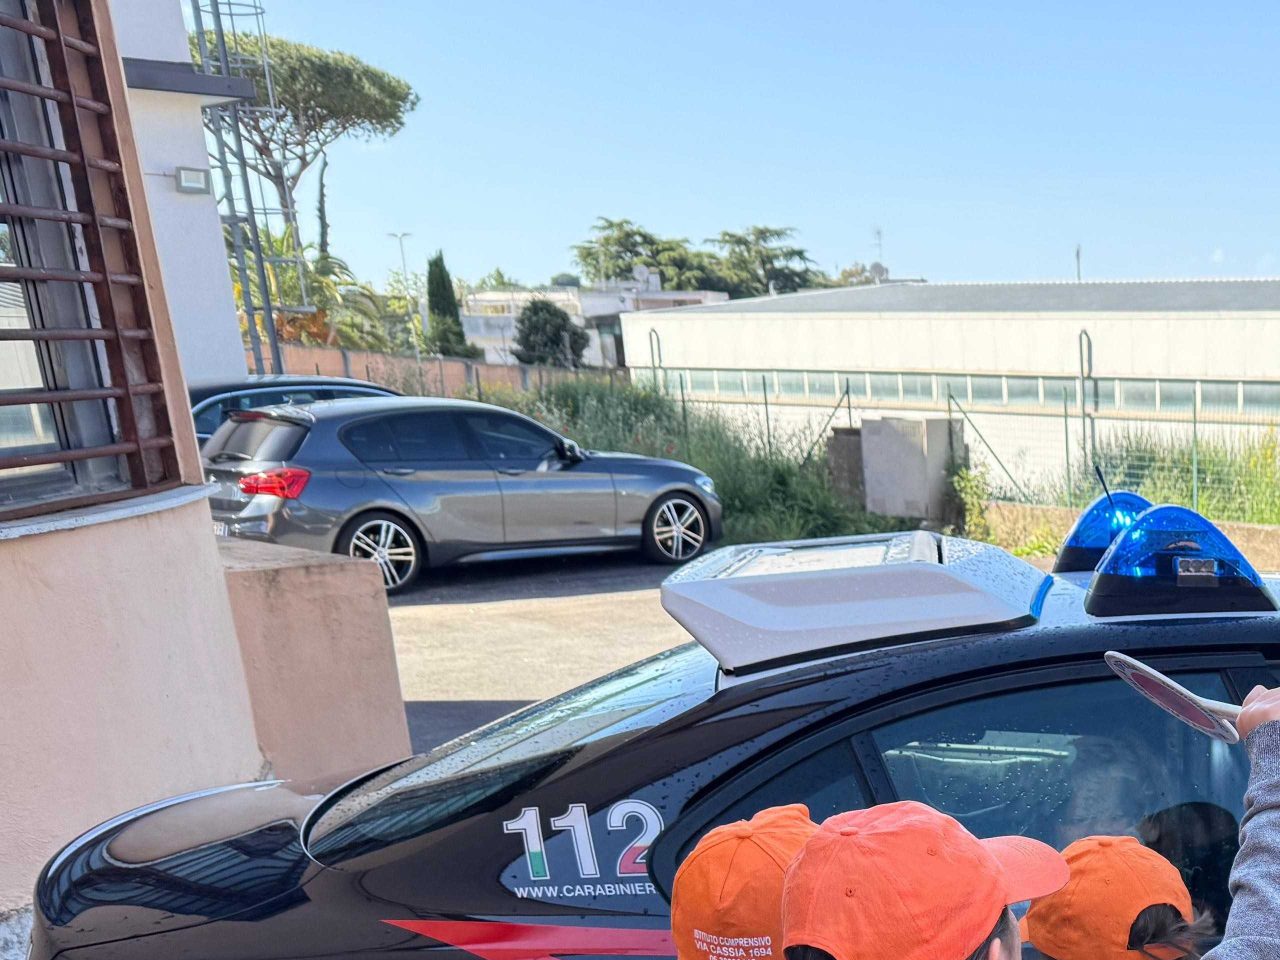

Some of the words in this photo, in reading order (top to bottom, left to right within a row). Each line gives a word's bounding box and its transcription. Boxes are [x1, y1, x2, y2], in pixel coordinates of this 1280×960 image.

[502, 799, 665, 880] 112
[514, 882, 657, 899] WWW.CARABINIER
[694, 940, 709, 952] VIA
[710, 945, 746, 957] CASSIA
[749, 948, 773, 957] 1694
[719, 936, 772, 947] COMPRENSIVO
